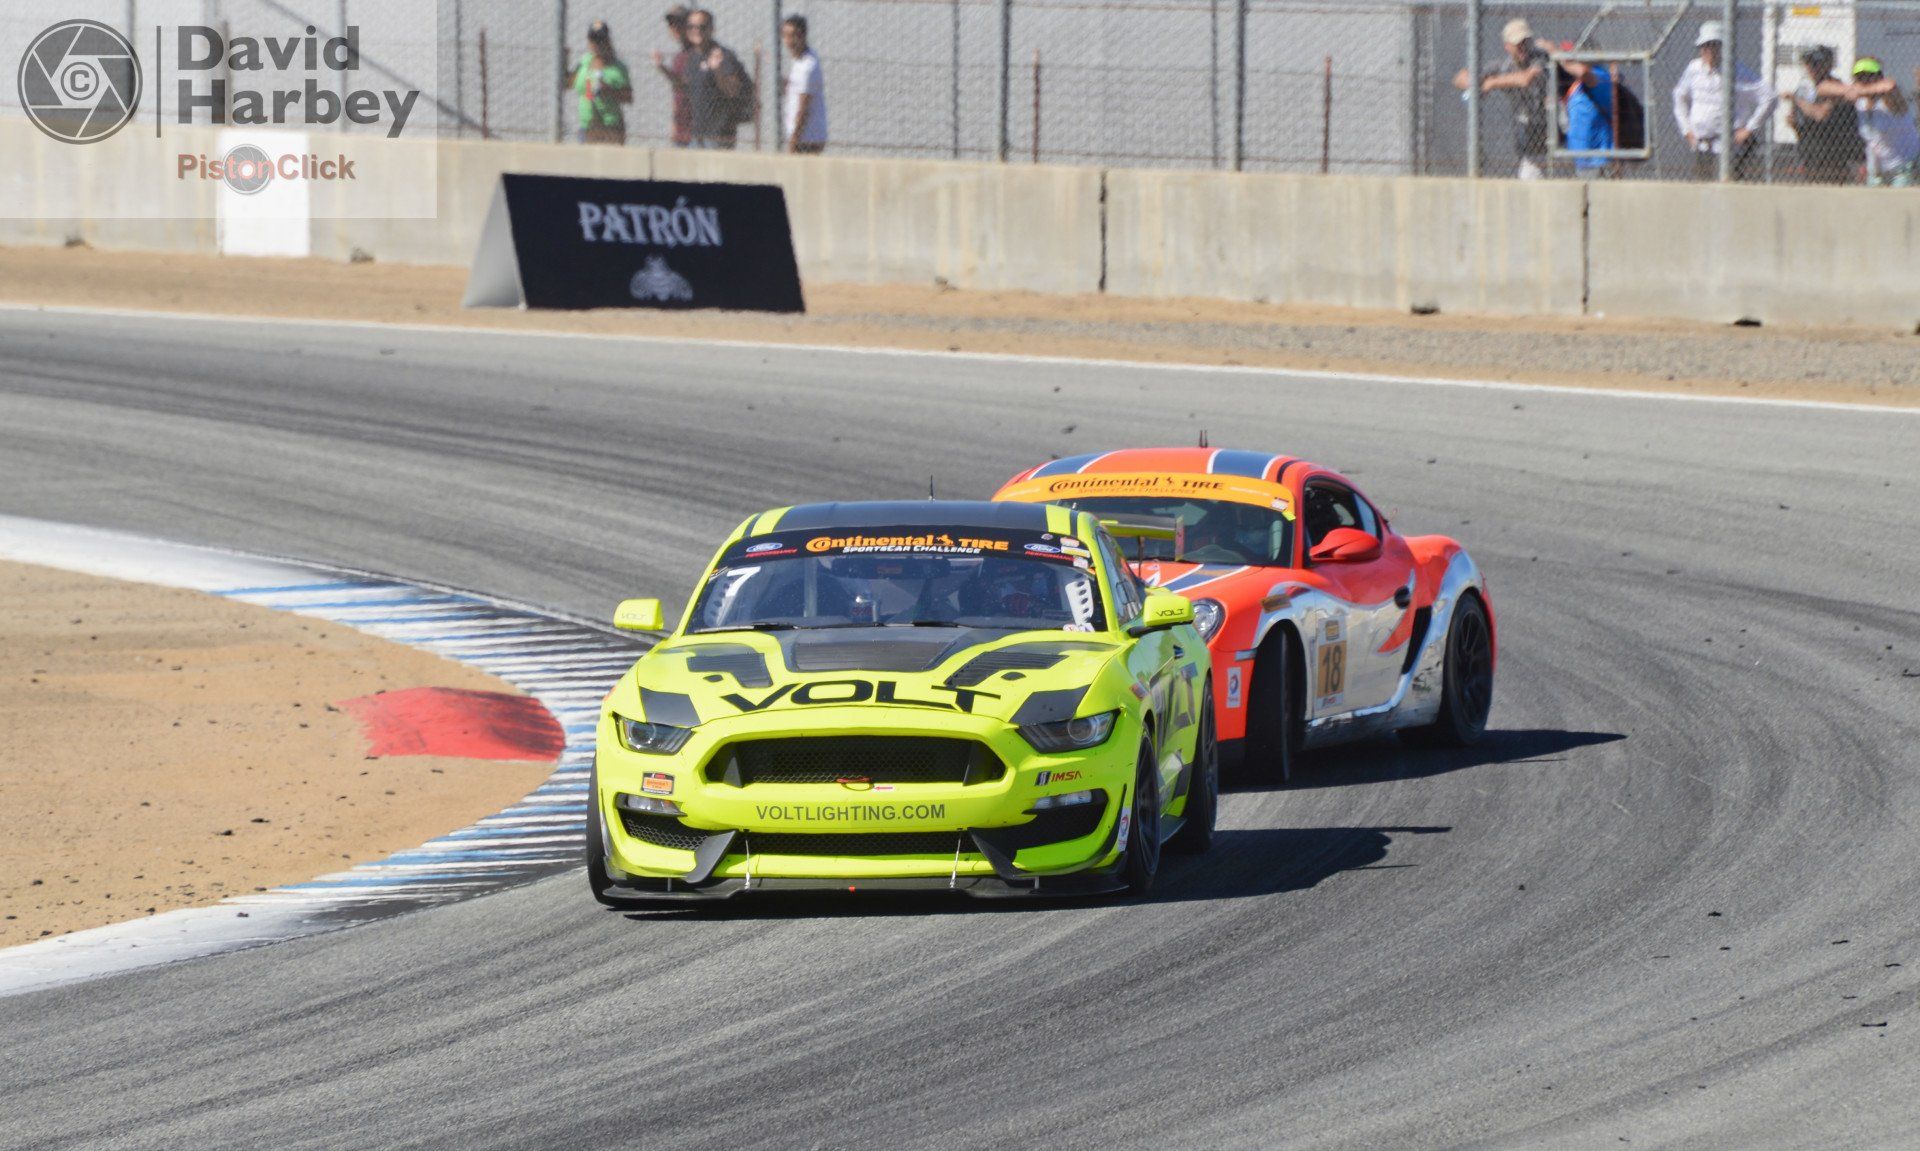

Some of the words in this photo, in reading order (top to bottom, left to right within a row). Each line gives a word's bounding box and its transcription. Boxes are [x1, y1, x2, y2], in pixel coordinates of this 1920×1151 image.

[578, 195, 722, 247] PATRÓN
[1049, 477, 1159, 493] Continental
[1182, 479, 1224, 490] TIRE
[806, 535, 933, 552] Continental
[958, 538, 1010, 551] TIRE
[842, 545, 910, 554] SPORTSCAR
[913, 545, 982, 554] CHALLENGE
[718, 566, 761, 612] 7
[1156, 608, 1184, 617] VOLT
[1323, 645, 1343, 693] 18
[720, 680, 1001, 713] VOLT
[1051, 770, 1083, 783] IMSA
[756, 803, 945, 821] VOLTLIGHTING.COM
